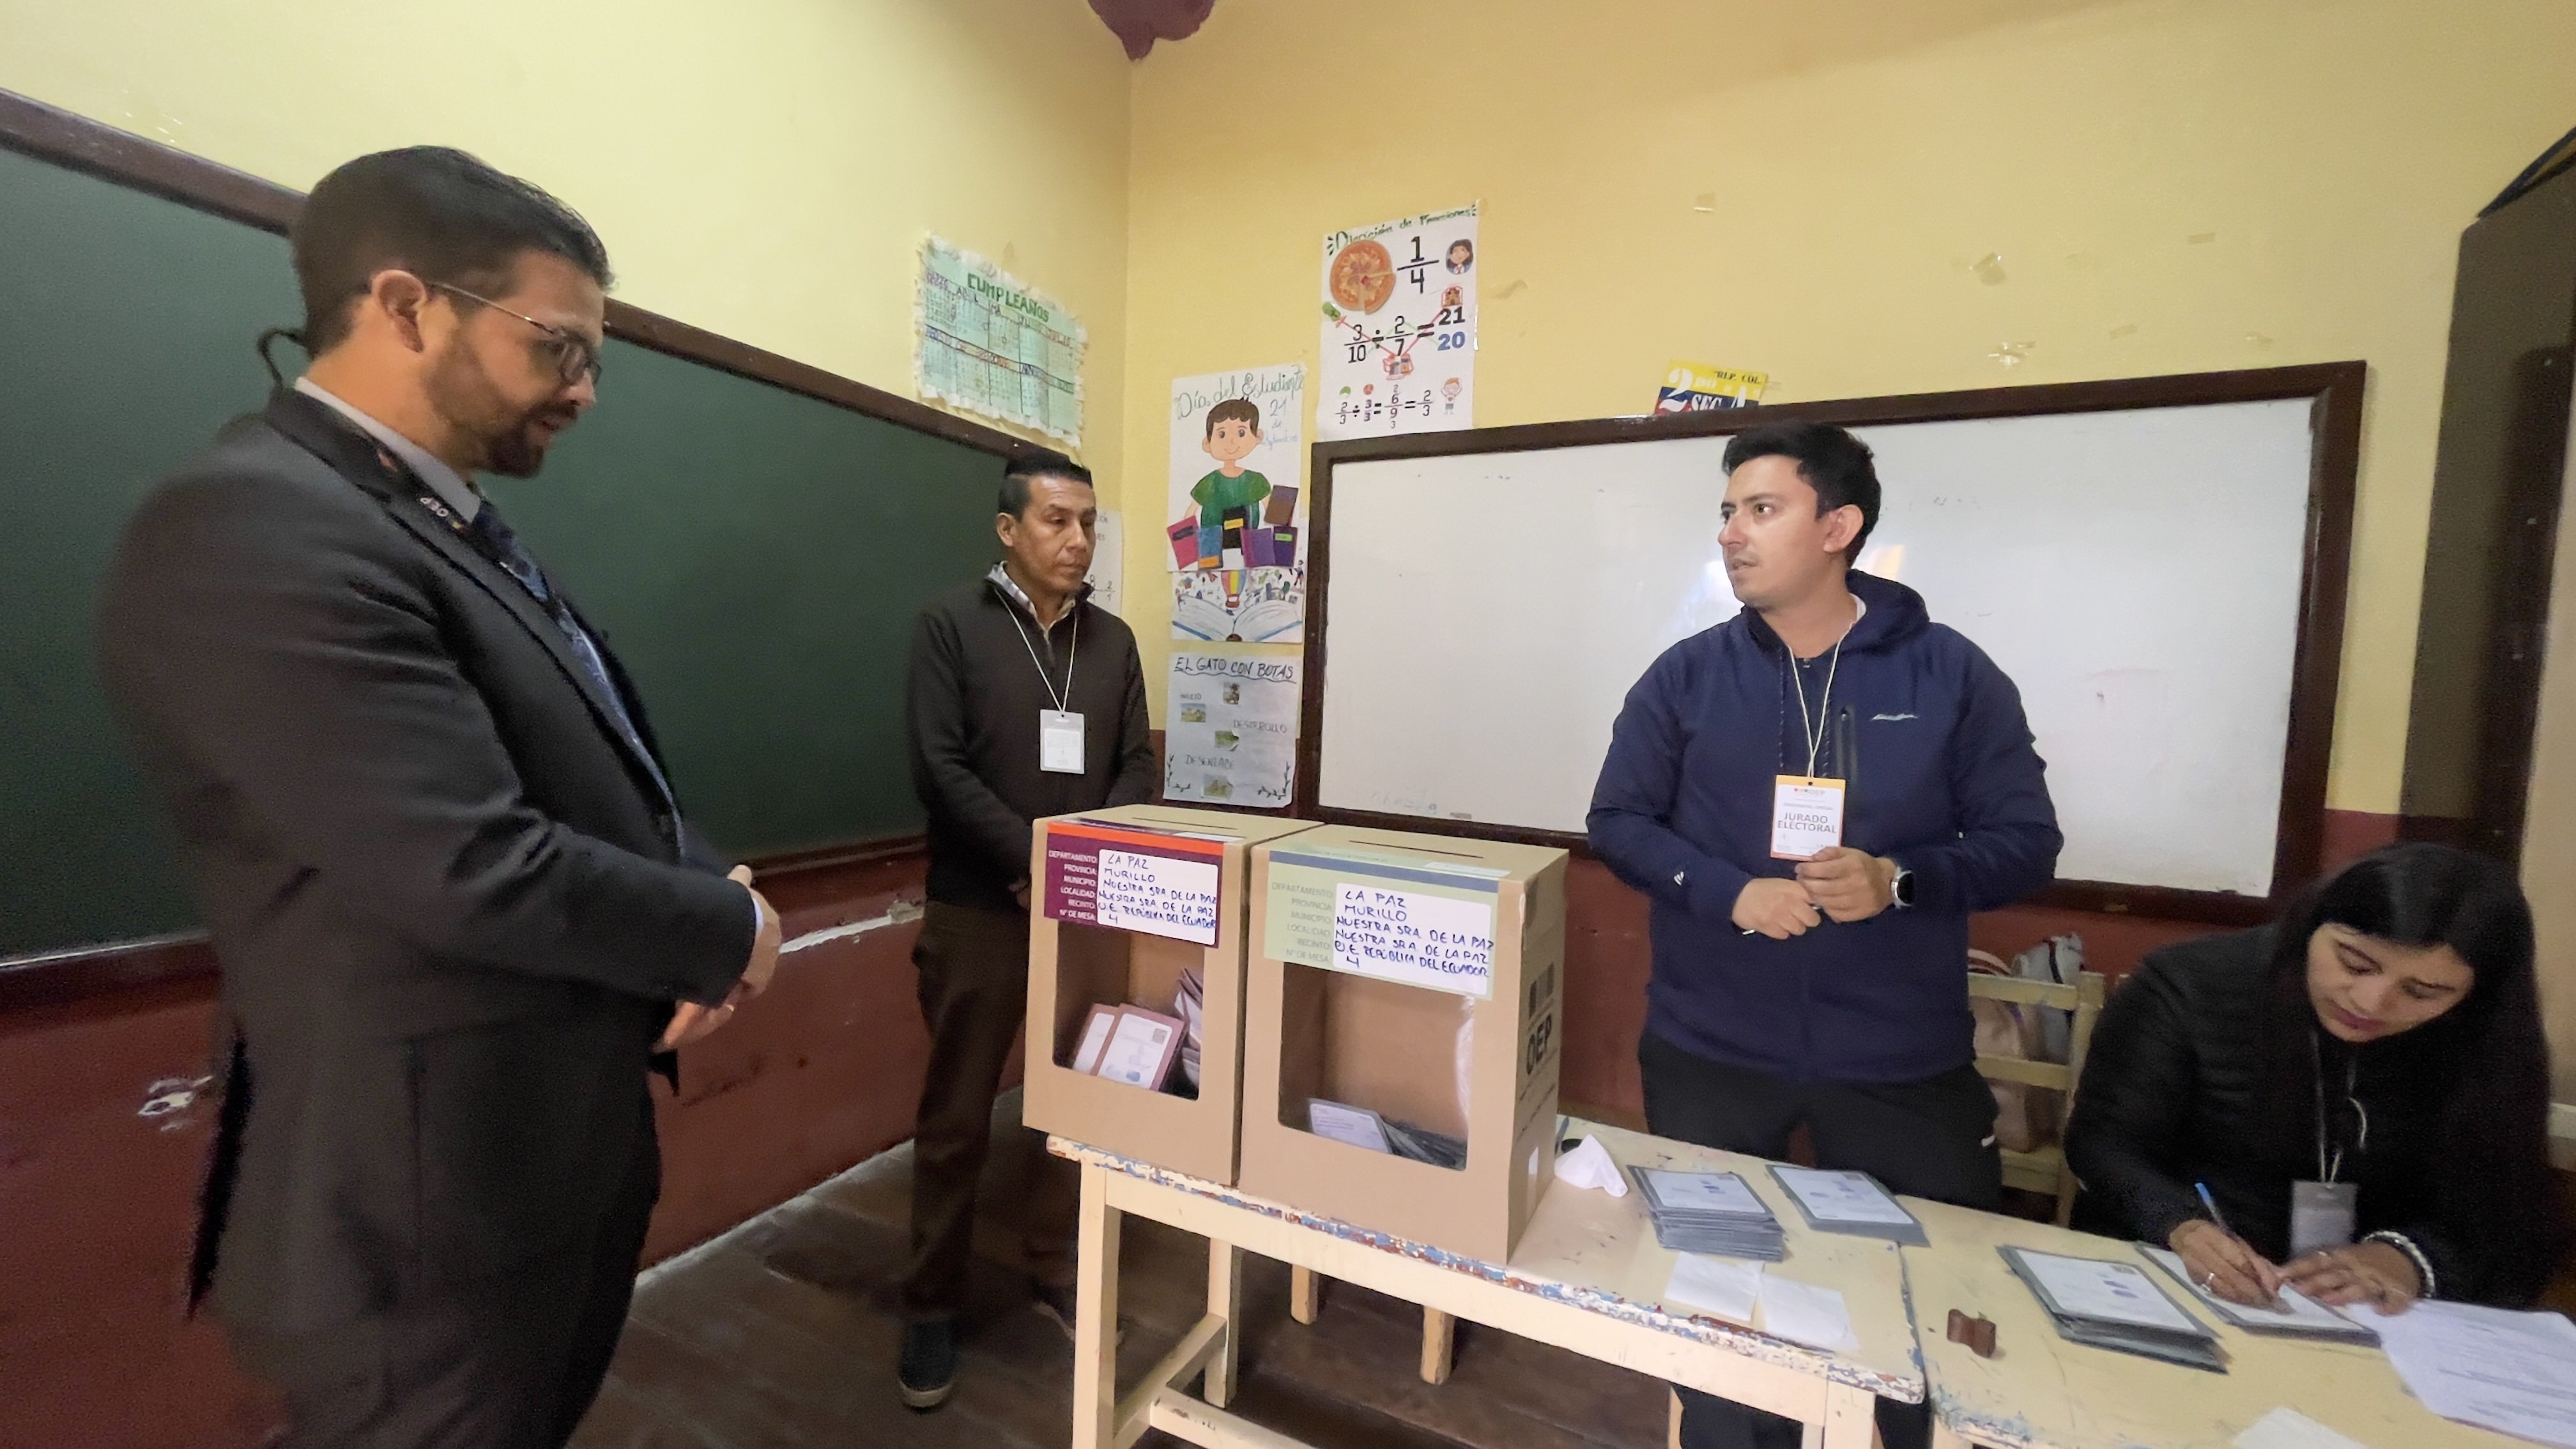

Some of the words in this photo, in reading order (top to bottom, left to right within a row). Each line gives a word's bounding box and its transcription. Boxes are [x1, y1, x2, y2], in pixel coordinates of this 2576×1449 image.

[1411, 236, 1425, 263] 1
[1410, 268, 1425, 294] 4
[967, 273, 1049, 323] CUMPLEAÑOS
[1353, 323, 1363, 341] 3
[1394, 316, 1406, 335] 2
[1438, 306, 1466, 326] 21
[1347, 344, 1367, 364] 10
[1394, 338, 1405, 356] 7
[1437, 331, 1466, 351] 20
[1213, 375, 1238, 403] del
[1659, 367, 1693, 413] 2
[1269, 397, 1287, 417] 21
[1340, 401, 1347, 412] 2
[1391, 393, 1399, 404] 6
[1423, 390, 1432, 402] 2
[1339, 415, 1346, 425] 3
[1422, 404, 1430, 417] 3
[1107, 580, 1113, 590] 2
[1175, 657, 1193, 671] EL
[1196, 657, 1227, 671] GATO
[1230, 662, 1254, 675] CON
[1257, 663, 1294, 680] BOTAS
[1777, 820, 1837, 834] ELECTORAL
[1784, 812, 1828, 824] JURADO
[1108, 854, 1121, 864] LA
[1128, 855, 1149, 870] PAZ
[1105, 868, 1155, 883] MURILLO
[1170, 890, 1183, 901] DE
[1200, 893, 1217, 905] PAZ
[1345, 890, 1365, 903] LA
[1375, 893, 1407, 909] PAZ
[1108, 914, 1119, 924] 4
[1162, 901, 1176, 912] DE
[1181, 904, 1192, 914] LA
[1197, 906, 1213, 917] PAZ
[1344, 904, 1407, 922] MURILLO
[1336, 916, 1392, 933] NUESTRA
[1397, 925, 1422, 939] SRA
[1429, 930, 1447, 944] DE
[1452, 933, 1466, 946] LA
[1471, 936, 1494, 951] PAZ
[1335, 928, 1386, 946] NUESTRA
[1393, 939, 1417, 951] SRA
[1425, 944, 1440, 957] DE
[1445, 948, 1459, 959] LA
[1463, 950, 1489, 965] PAZ
[1346, 956, 1360, 969] 4
[1419, 956, 1439, 970] DEL
[1441, 960, 1490, 978] ECUADOR
[1526, 1014, 1552, 1075] OEP
